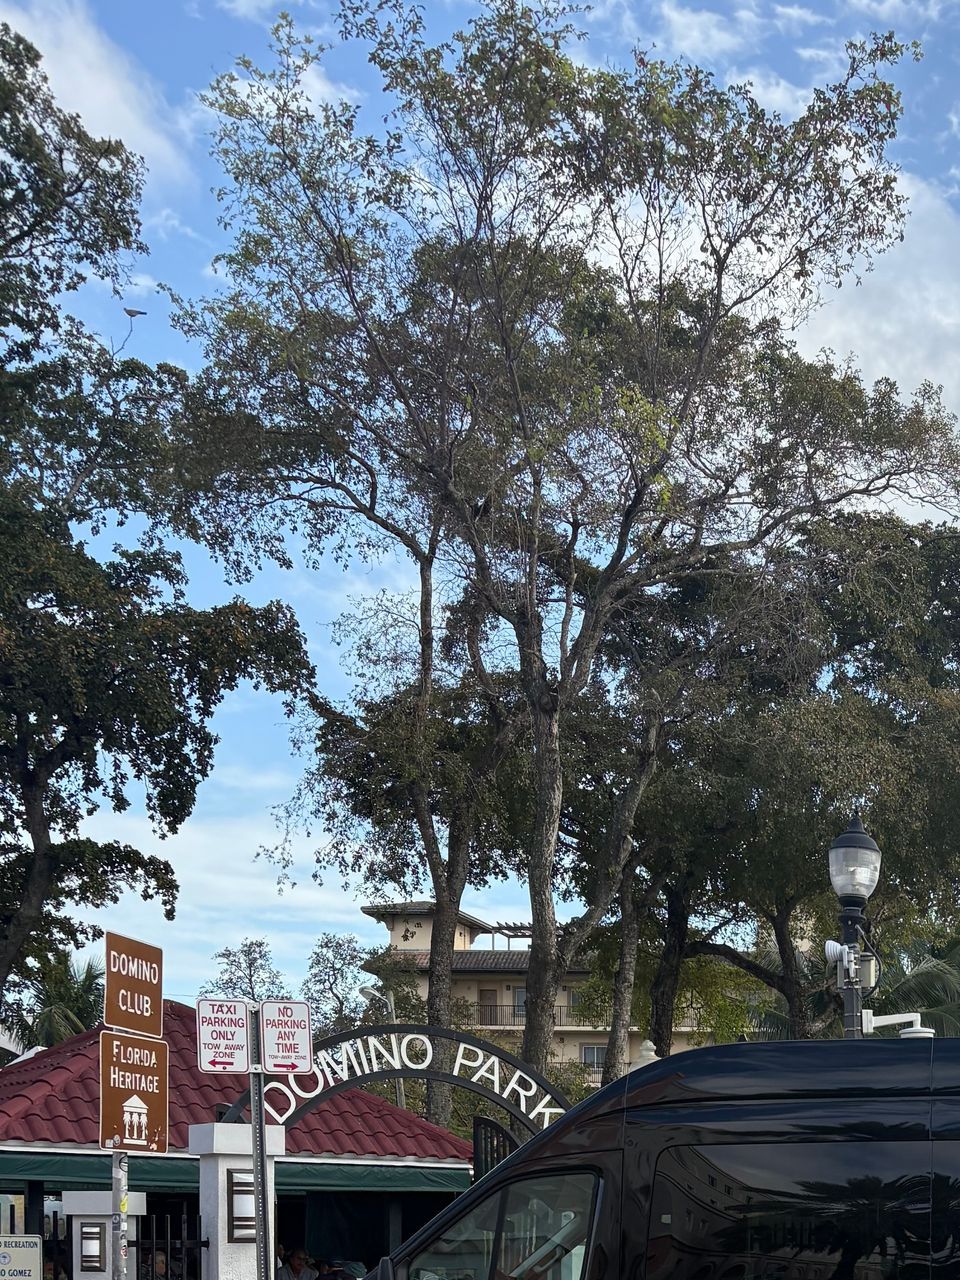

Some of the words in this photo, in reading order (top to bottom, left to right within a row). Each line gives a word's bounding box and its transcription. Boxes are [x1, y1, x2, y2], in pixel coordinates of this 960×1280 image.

[110, 951, 158, 984] DOMINO
[118, 989, 151, 1016] CLUB
[209, 1003, 236, 1015] TAXI
[278, 1007, 293, 1018] NO
[201, 1016, 245, 1028] PARKING
[265, 1018, 307, 1030] PARKING
[210, 1029, 236, 1041] ONLY
[277, 1031, 296, 1041] ANY
[202, 1042, 221, 1050] TOW
[224, 1043, 245, 1051] AWAY
[275, 1042, 300, 1054] TIME
[112, 1040, 157, 1068] FLORIDA
[213, 1051, 236, 1059] ZONE
[110, 1065, 160, 1094] HERITAGE
[262, 1033, 434, 1124] DOMINO
[453, 1042, 566, 1129] PARK
[4, 1240, 38, 1249] RECREATION
[8, 1269, 32, 1277] GOMEZ
